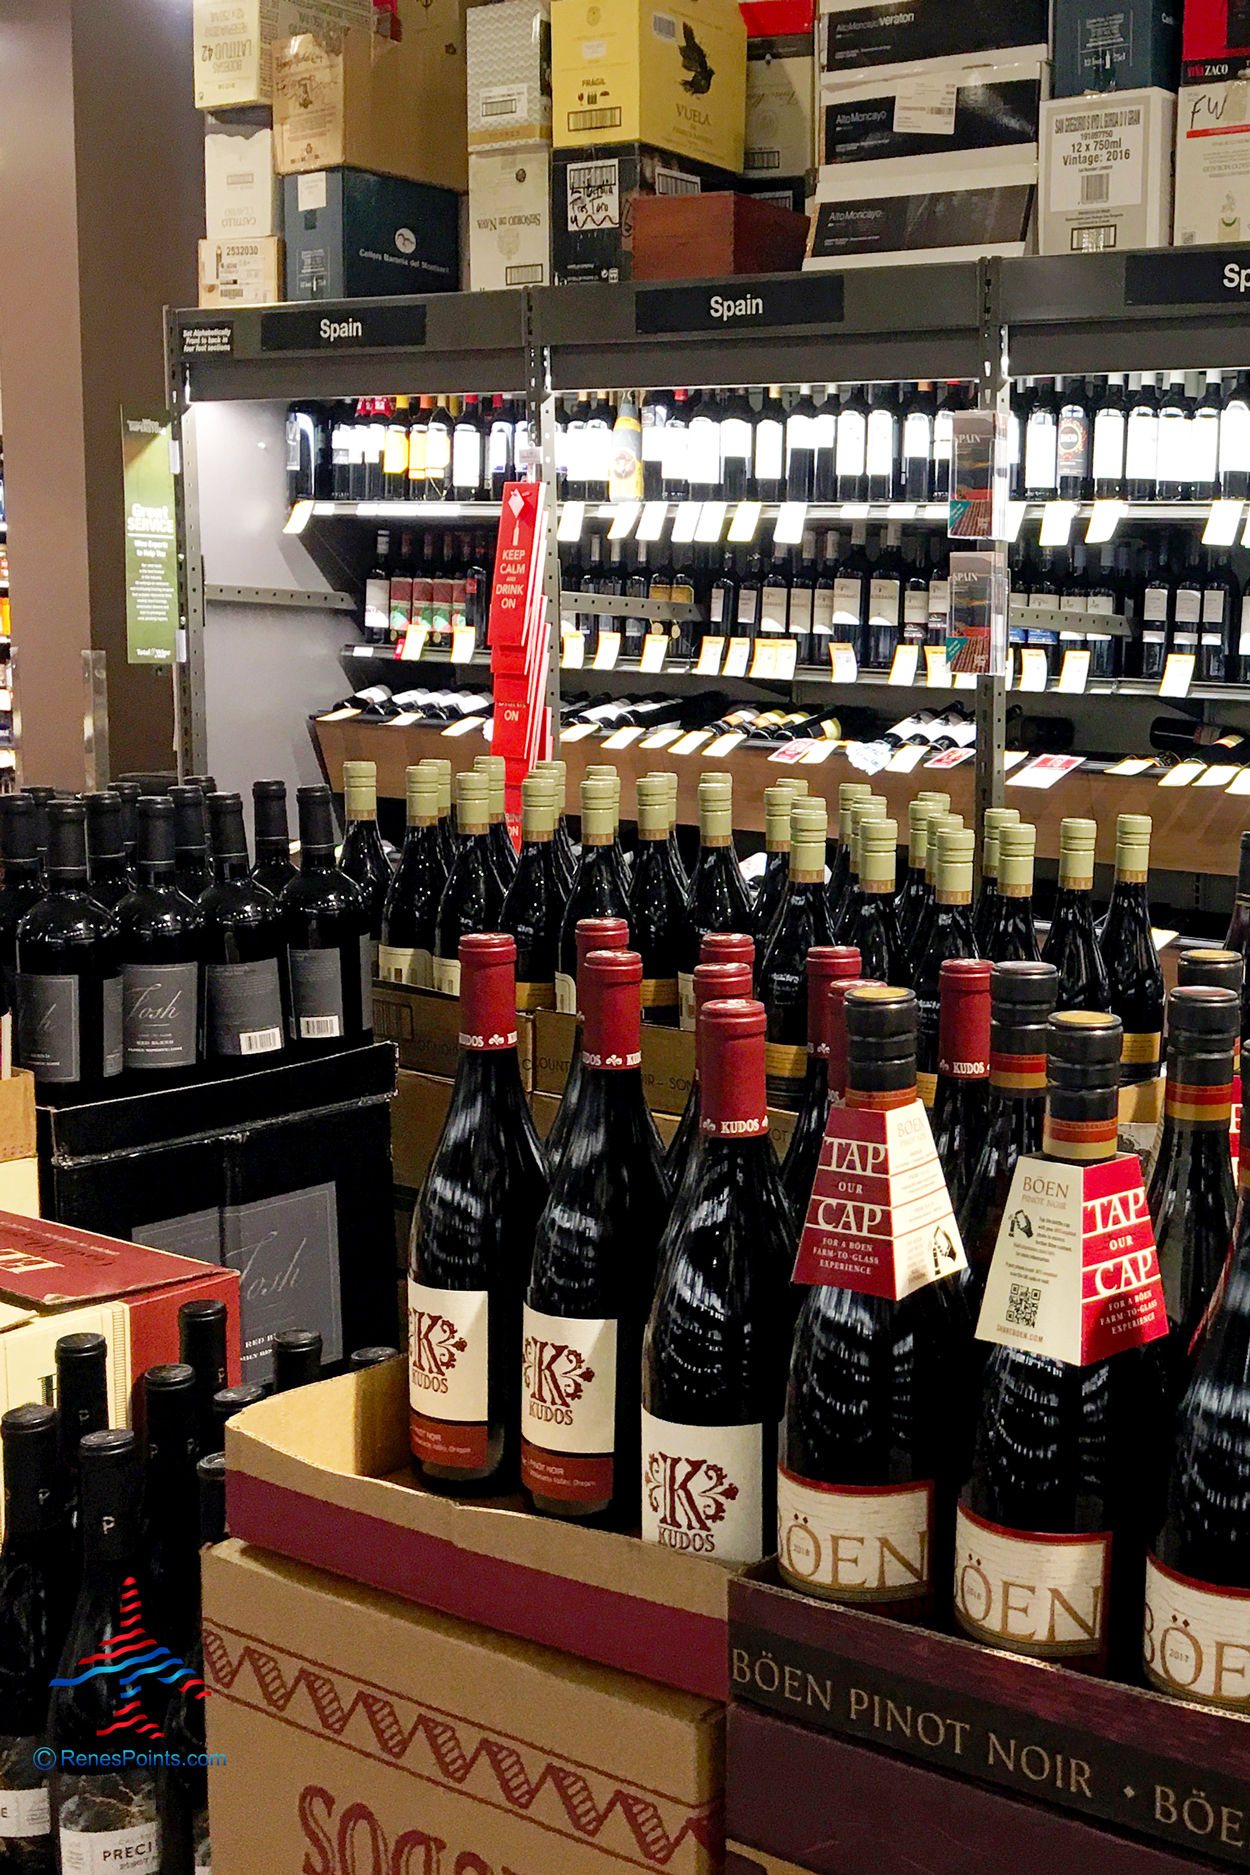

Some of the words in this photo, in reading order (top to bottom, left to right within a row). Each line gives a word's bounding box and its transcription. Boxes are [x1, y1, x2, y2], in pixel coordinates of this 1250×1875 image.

[201, 45, 213, 62] 42
[1204, 64, 1229, 76] ZACO
[676, 103, 711, 126] VUELA
[1071, 143, 1082, 153] 12
[1085, 143, 1091, 152] x
[1094, 137, 1122, 151] 750ml
[1062, 153, 1103, 166] Vintage:
[1106, 149, 1130, 162] 2016
[710, 295, 763, 320] Spain
[319, 318, 362, 342] Spain
[954, 433, 981, 443] SPAIN
[132, 503, 169, 520] Great
[127, 517, 174, 533] SERVICE
[502, 549, 526, 561] KEEP
[499, 562, 526, 574] CALM
[951, 572, 978, 582] SPAIN
[496, 584, 524, 596] DRINK
[501, 598, 516, 609] ON
[504, 710, 519, 721] ON
[952, 1061, 985, 1074] KUDOS
[721, 1118, 760, 1134] KUDOS
[825, 1138, 886, 1177] TAP
[838, 1181, 864, 1195] OUR
[1021, 1175, 1069, 1199] BÖEN
[816, 1198, 883, 1237] CAP
[1087, 1187, 1145, 1233] TAP
[822, 1236, 837, 1247] FOR
[839, 1237, 847, 1248] A
[1108, 1235, 1134, 1249] OUR
[812, 1246, 880, 1266] FARM-TO-GLASS
[819, 1258, 872, 1275] EXPERIENCE
[1094, 1253, 1152, 1296] CAP
[1100, 1299, 1158, 1326] FARM-TO-GLASS
[1108, 1299, 1123, 1312] FOR
[1125, 1297, 1133, 1307] A
[1110, 1312, 1156, 1334] EXPERIENCE
[245, 1337, 265, 1349] RED
[411, 1370, 448, 1394] KUDOS
[528, 1401, 573, 1426] KUDOS
[101, 1516, 116, 1535] P
[658, 1525, 716, 1553] KUDOS
[1168, 1648, 1190, 1664] 2017
[732, 1647, 833, 1711] BÖEN
[849, 1688, 969, 1754] PINOT
[988, 1733, 1092, 1798] NOIR
